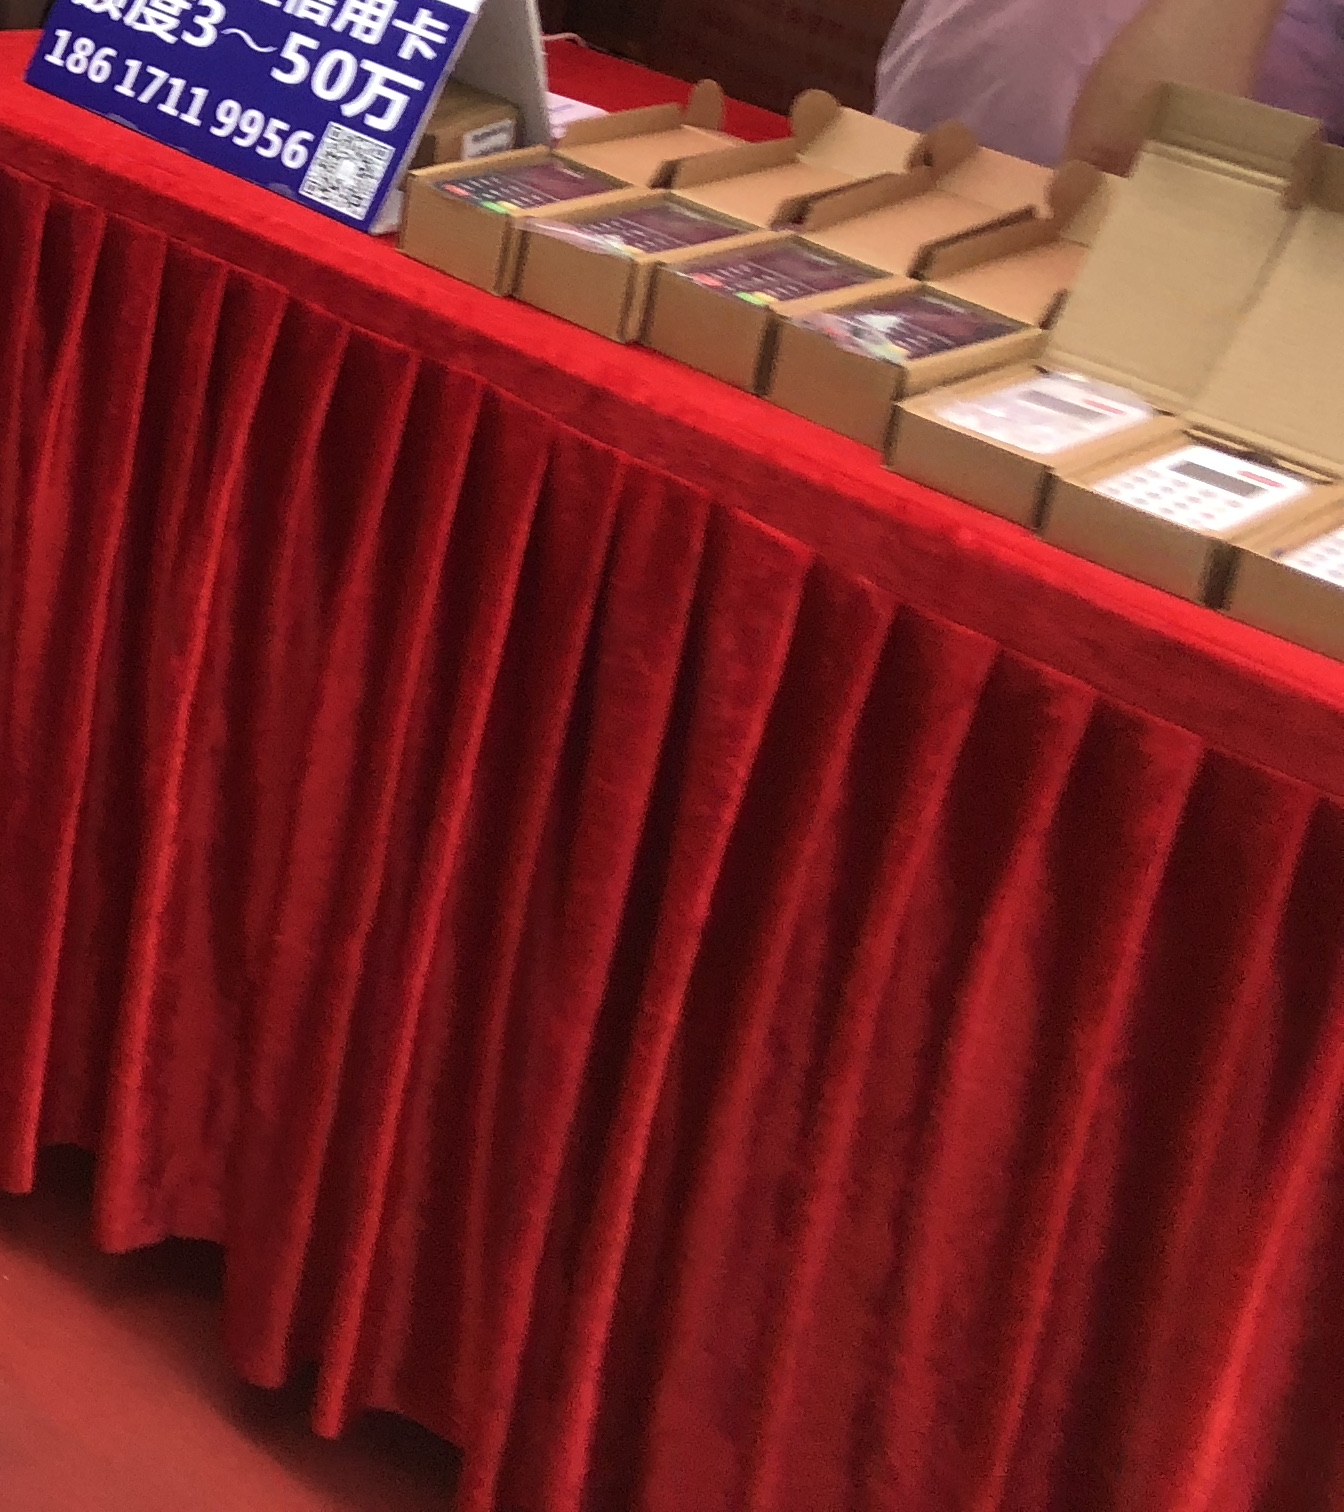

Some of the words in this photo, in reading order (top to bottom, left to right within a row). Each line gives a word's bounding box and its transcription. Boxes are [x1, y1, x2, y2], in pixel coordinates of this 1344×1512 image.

[43, 28, 118, 85] 186
[113, 57, 207, 129] 1711
[209, 97, 317, 170] 9956
